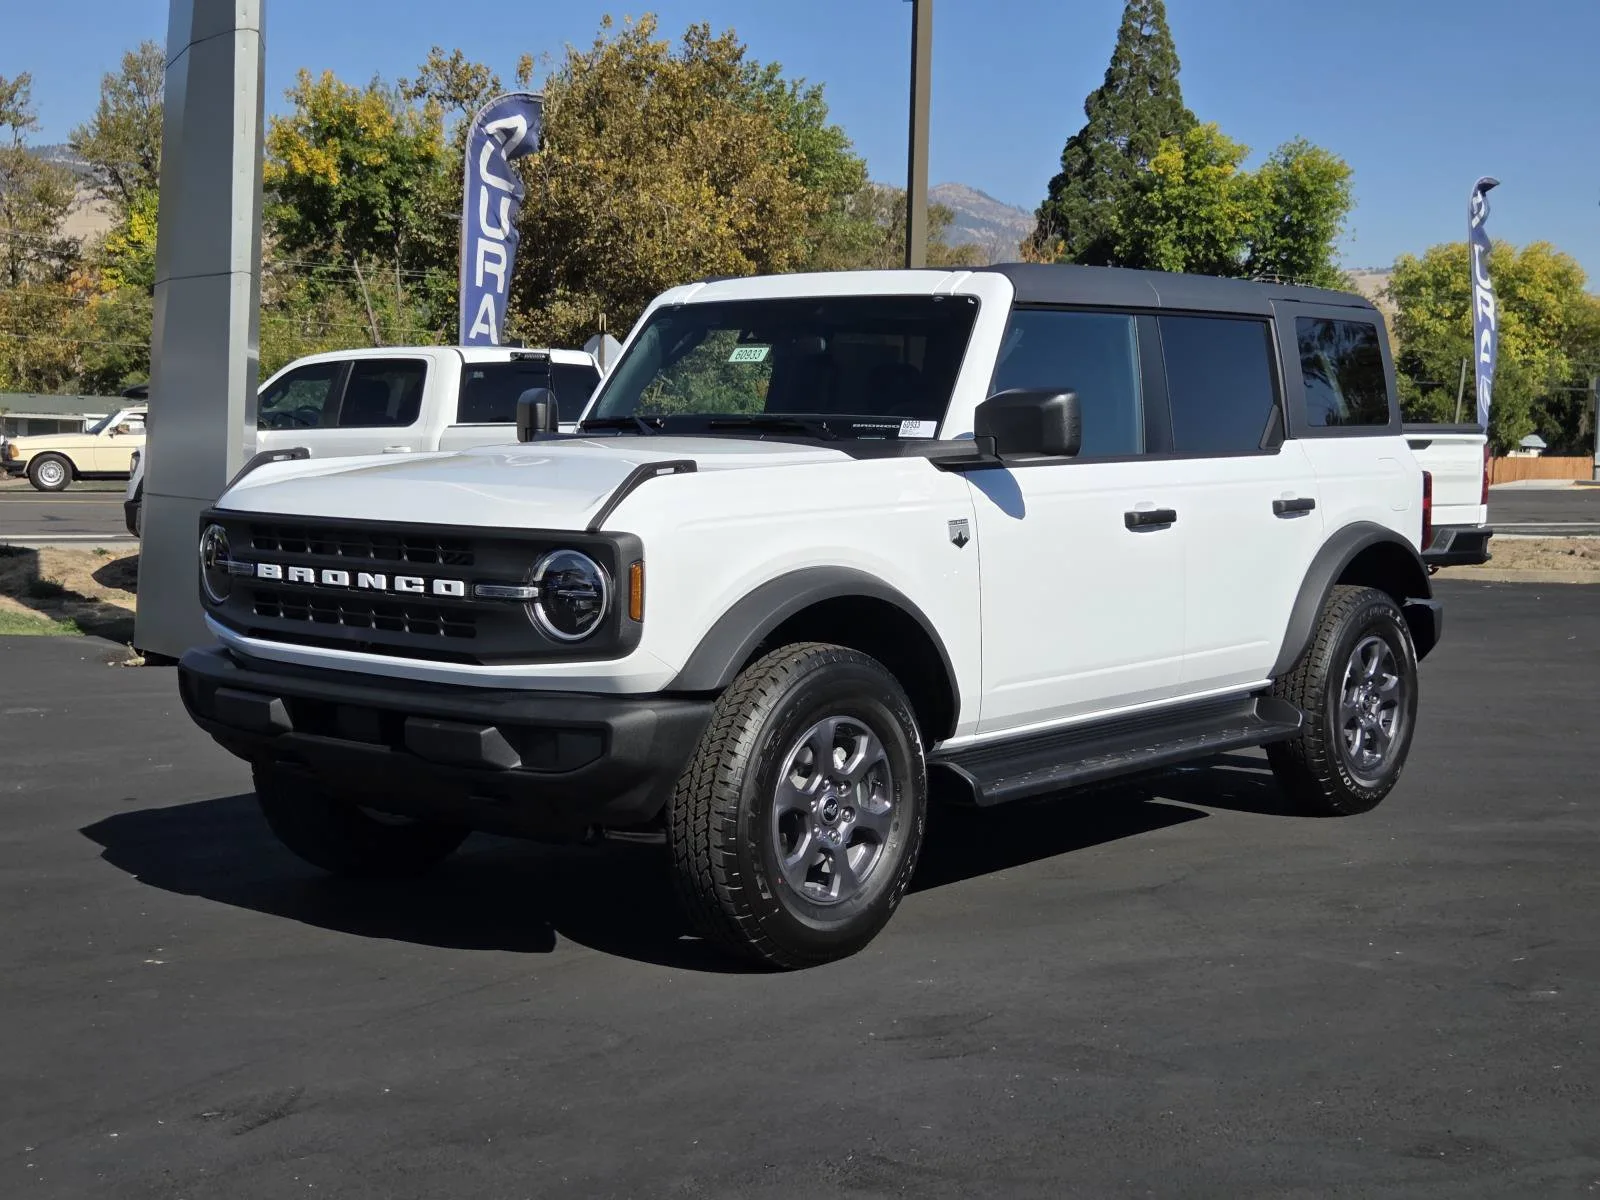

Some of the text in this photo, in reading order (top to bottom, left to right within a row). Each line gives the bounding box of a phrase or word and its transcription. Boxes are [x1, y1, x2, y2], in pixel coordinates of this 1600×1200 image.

[469, 114, 527, 344] ACURA
[735, 349, 763, 360] 60933
[257, 563, 465, 597] BRONCO
